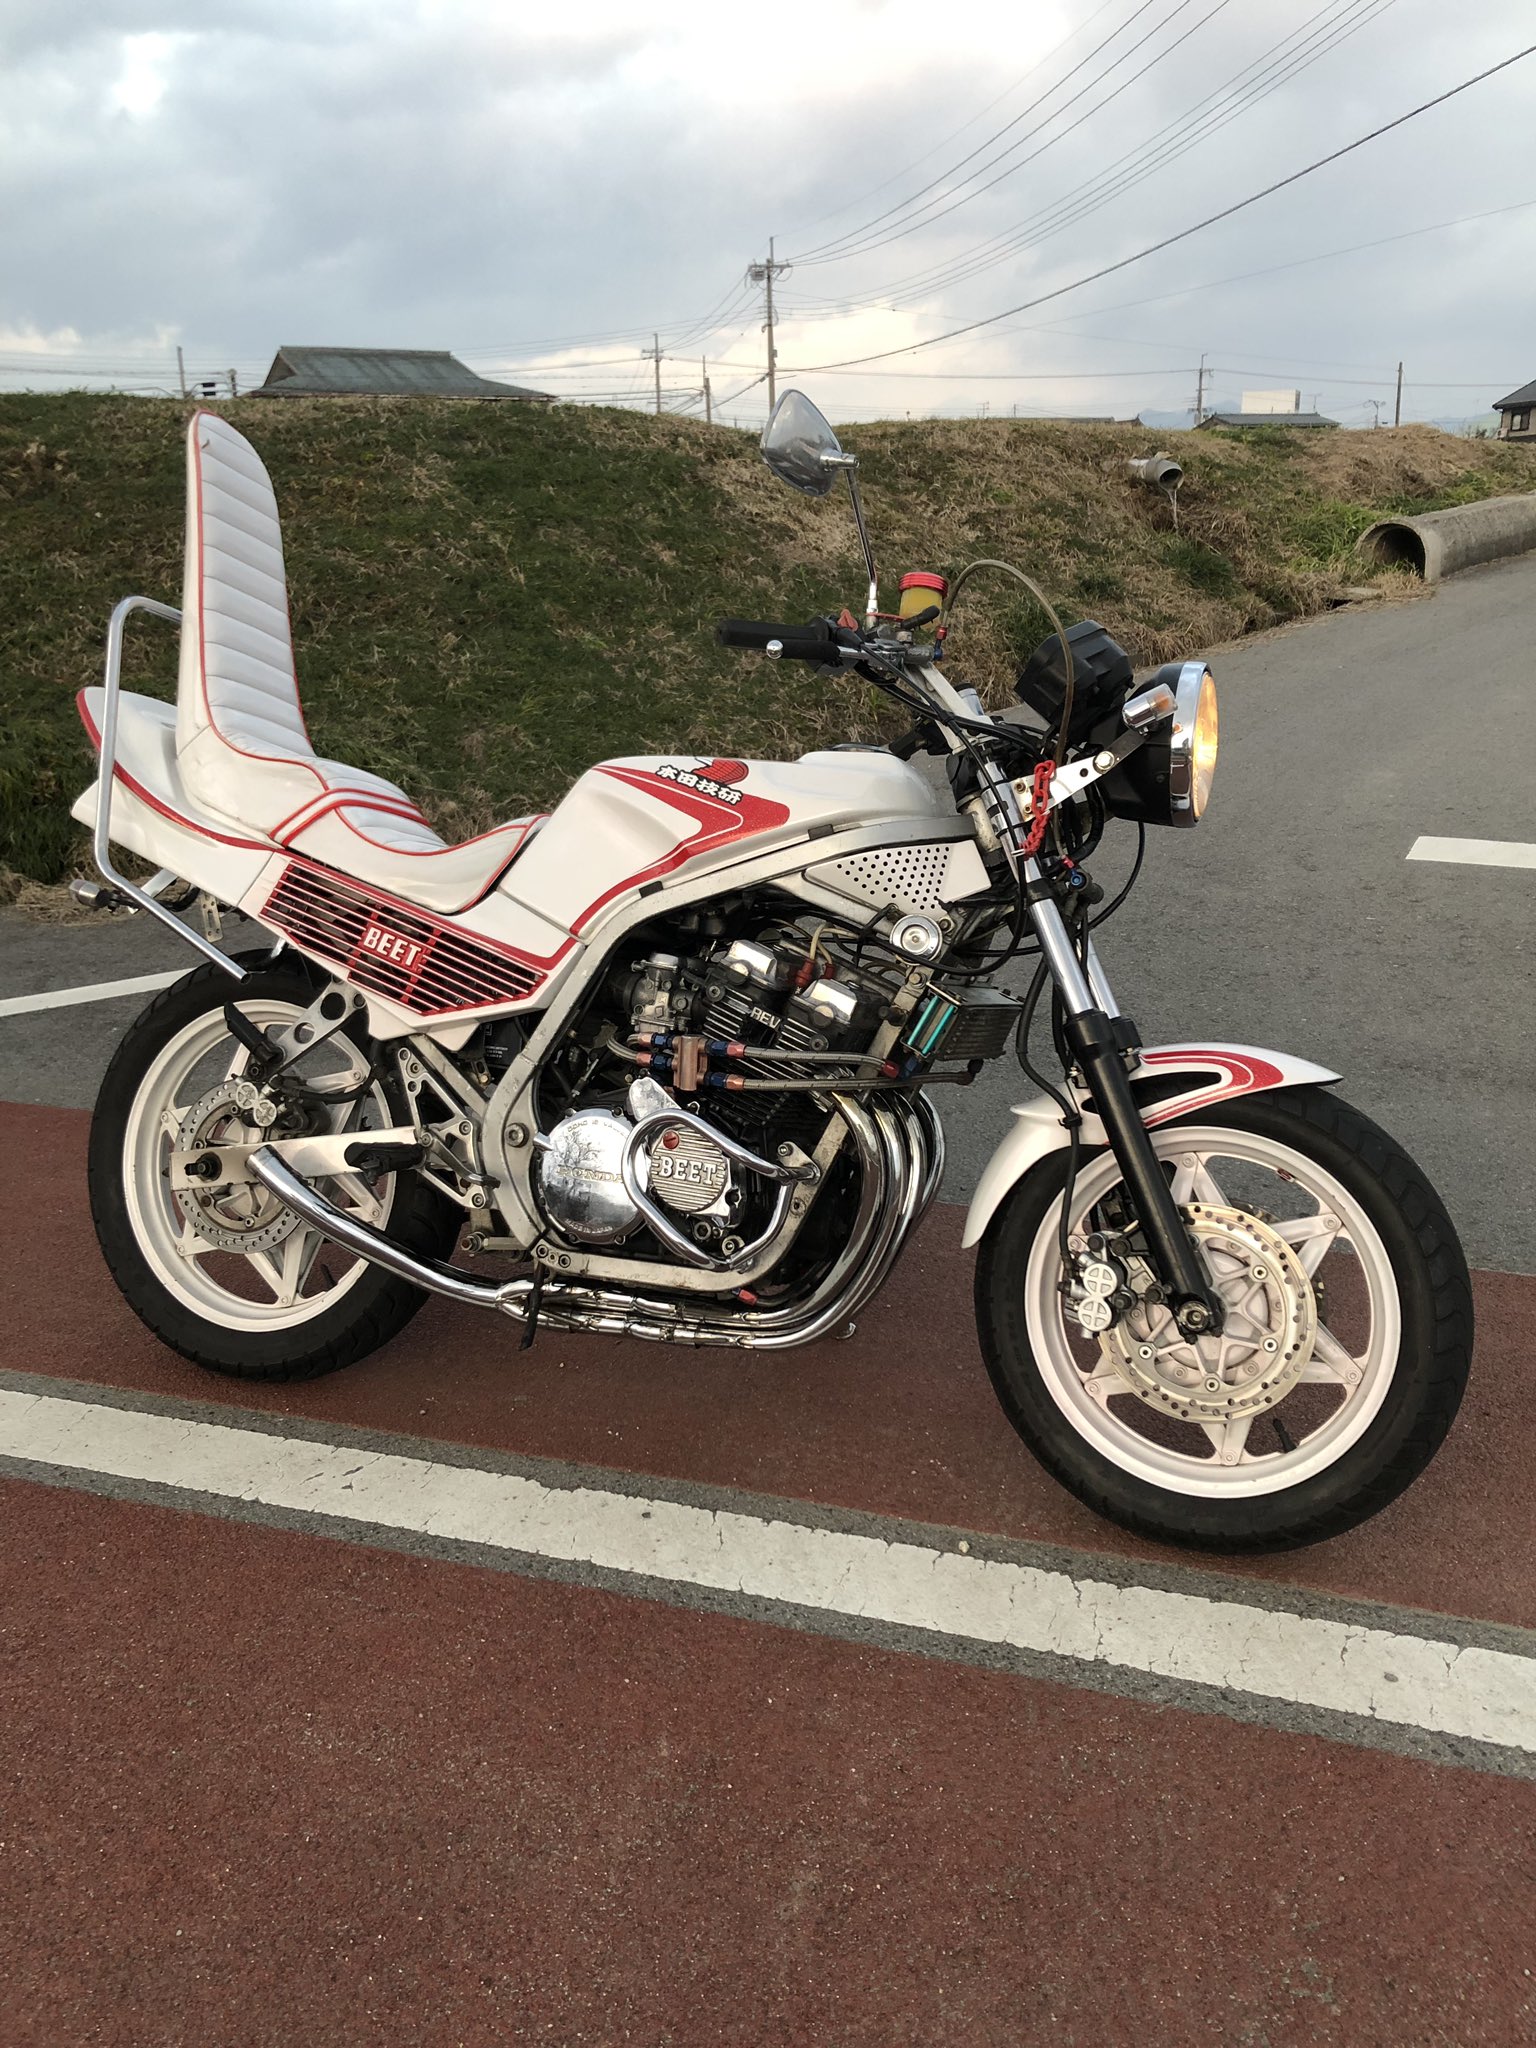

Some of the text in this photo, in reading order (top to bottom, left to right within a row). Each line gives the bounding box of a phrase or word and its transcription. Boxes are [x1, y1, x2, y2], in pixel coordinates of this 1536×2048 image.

[656, 765, 742, 805] 本田技研
[363, 927, 421, 966] BEET
[750, 1006, 781, 1029] REV
[659, 1156, 718, 1185] BEET
